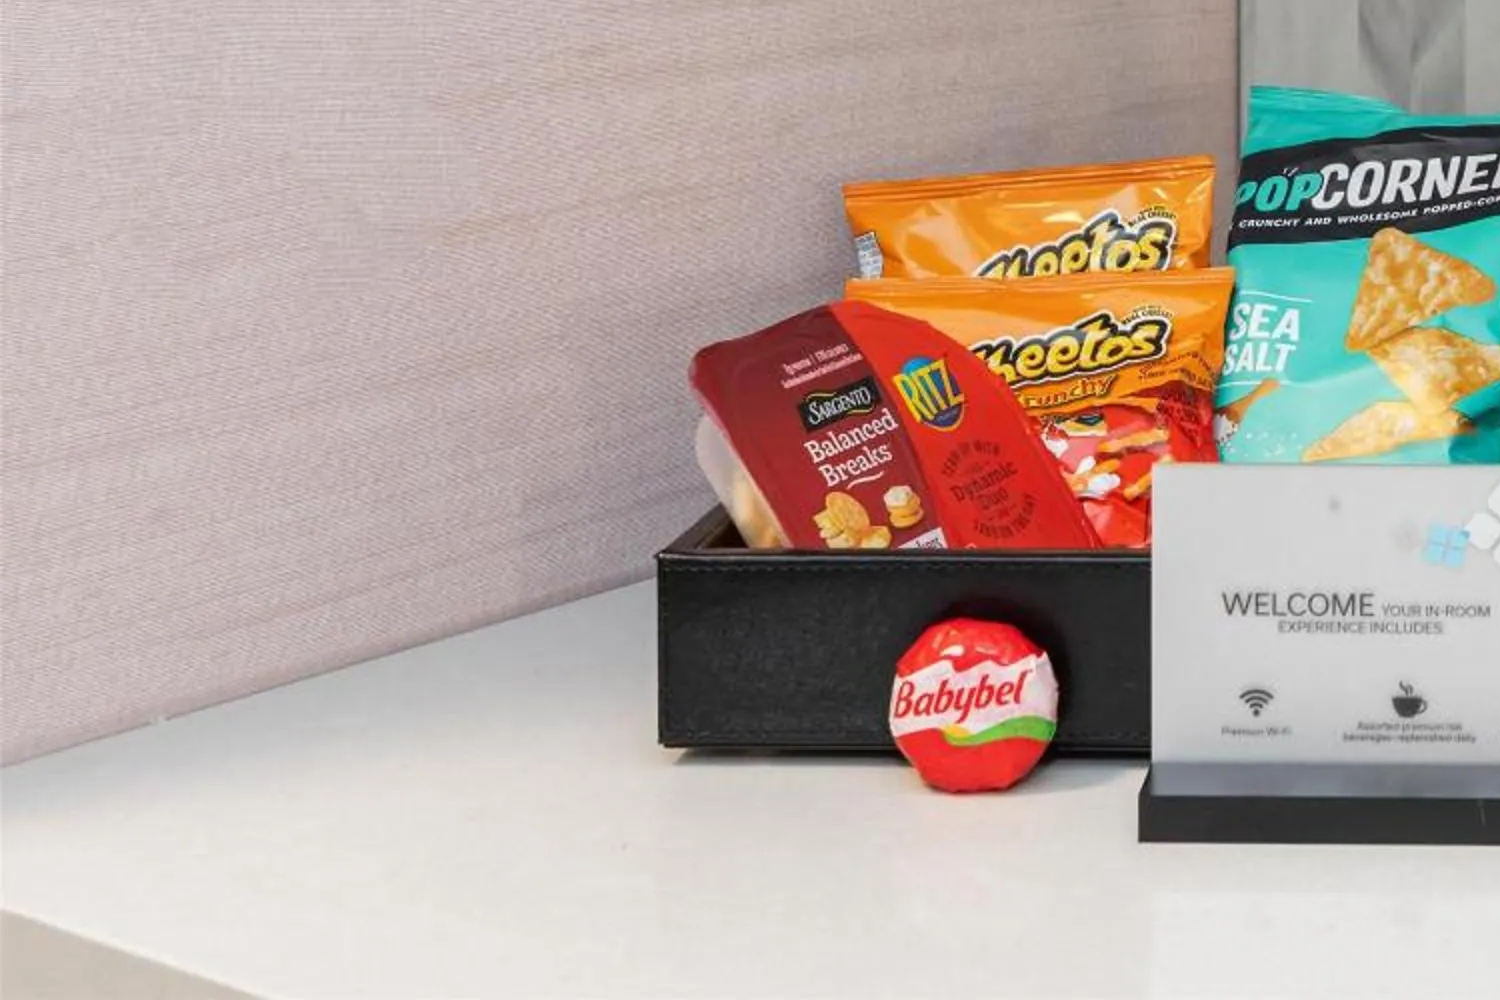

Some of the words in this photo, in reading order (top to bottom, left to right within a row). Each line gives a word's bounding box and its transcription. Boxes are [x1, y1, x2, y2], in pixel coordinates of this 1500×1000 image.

[1238, 217, 1300, 229] CRUNCHY
[1304, 216, 1333, 226] AND
[1337, 207, 1418, 225] WHOLESOME
[1229, 302, 1300, 341] SEA
[970, 311, 1172, 388] heetos
[1222, 340, 1297, 377] SALT
[892, 358, 966, 424] RITZ
[1018, 373, 1118, 409] runchy
[803, 407, 899, 464] Balanced
[818, 443, 894, 488] Breaks
[1221, 591, 1375, 618] WELCOME
[1381, 603, 1421, 618] YOUR
[1424, 603, 1492, 618] IN-ROOM
[1277, 620, 1365, 635] EXPERIENCE
[894, 668, 1030, 725] Babybel
